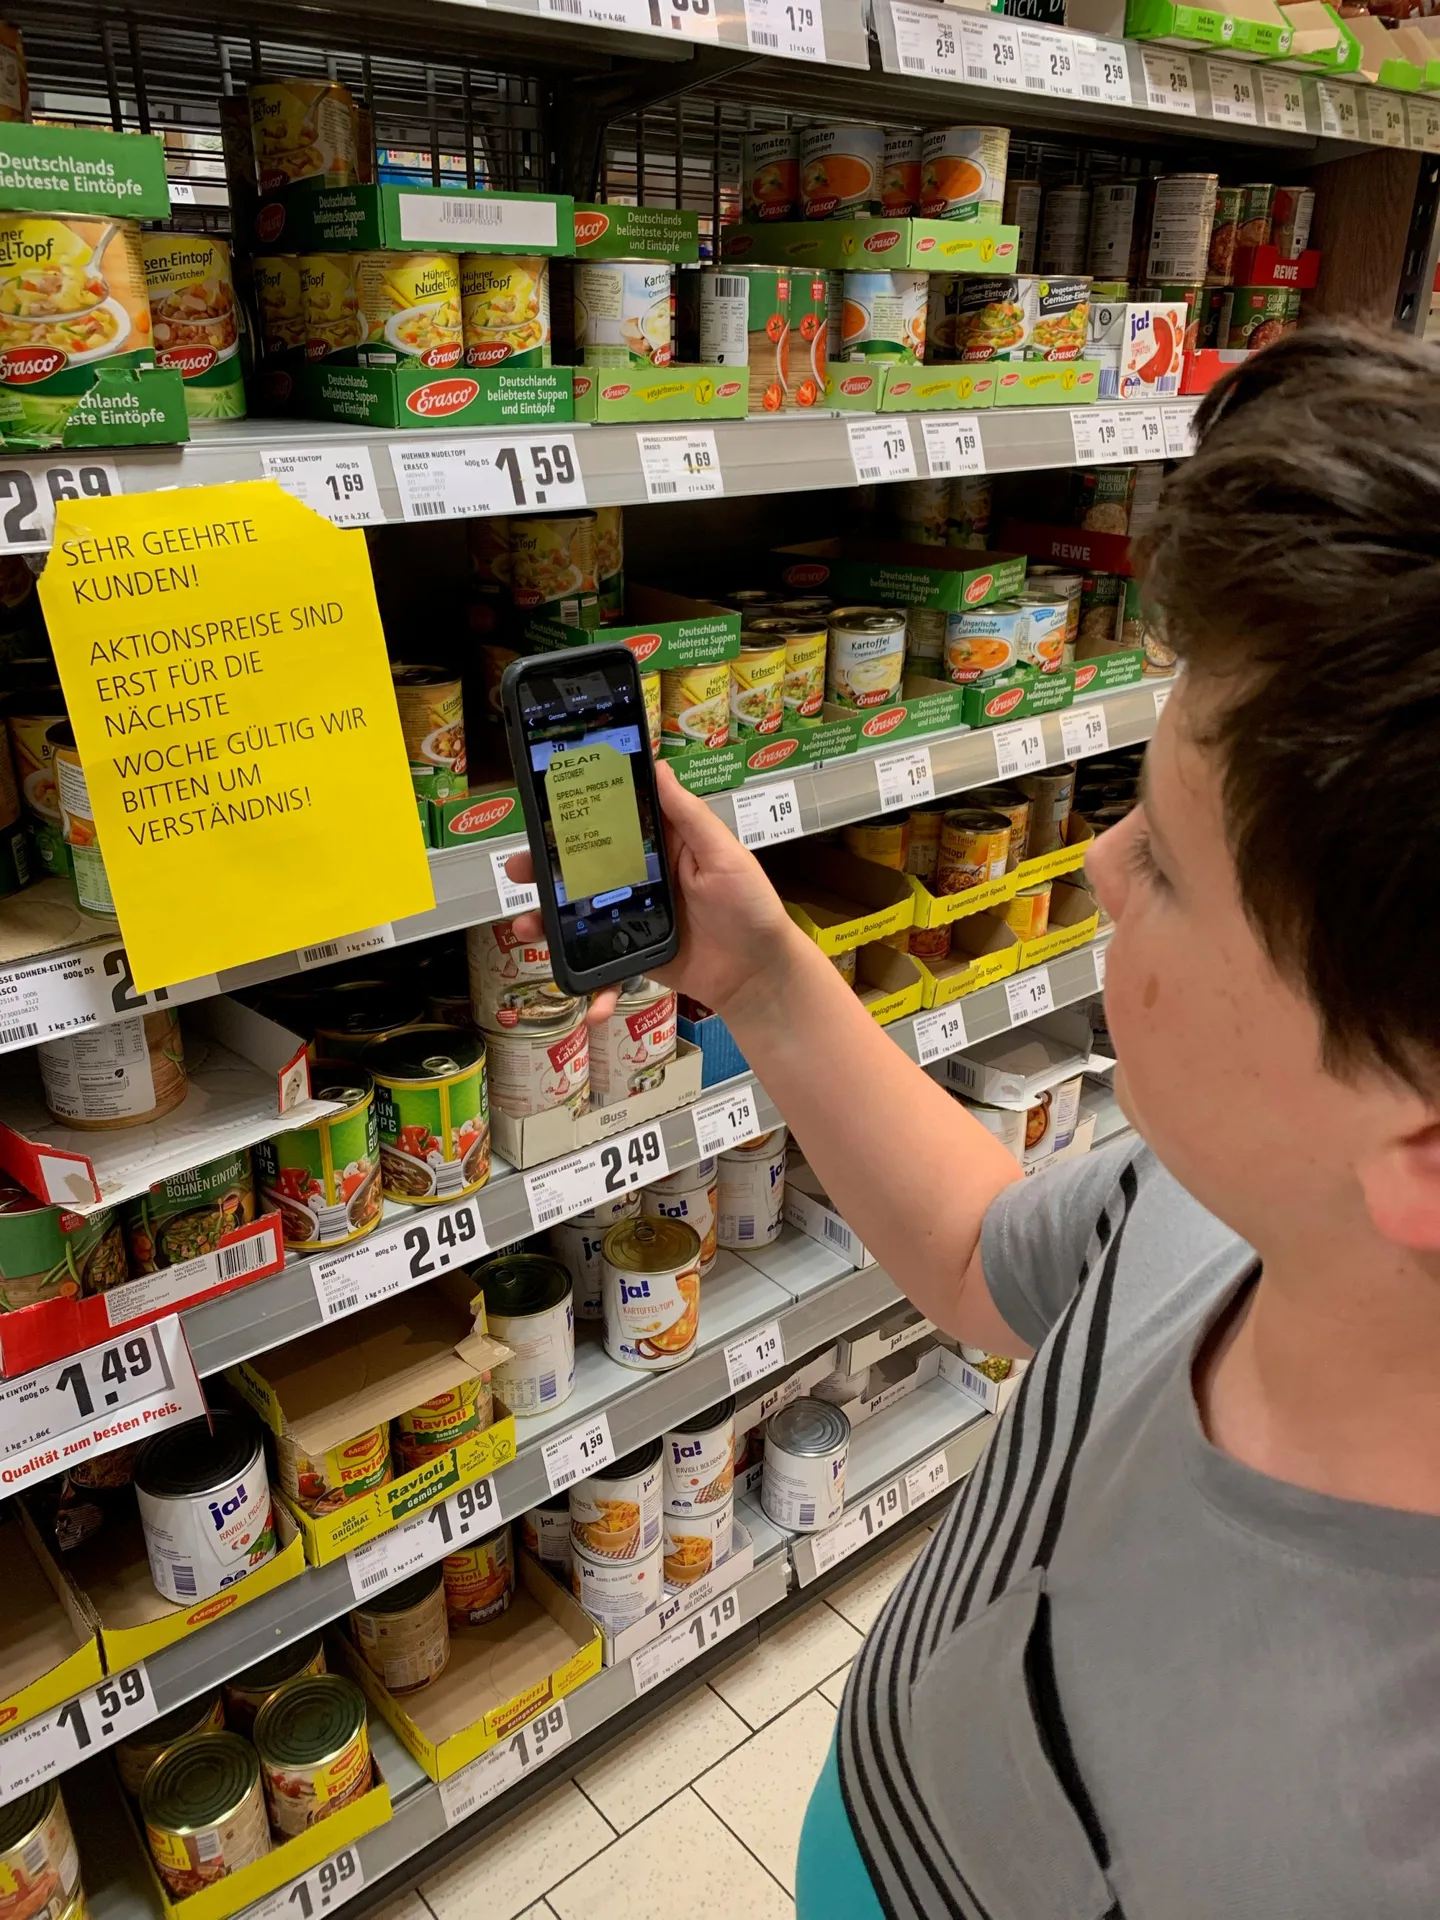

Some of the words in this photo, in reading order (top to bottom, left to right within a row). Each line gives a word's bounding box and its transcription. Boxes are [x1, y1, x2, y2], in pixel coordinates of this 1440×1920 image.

[786, 6, 814, 34] 1.79
[936, 38, 955, 58] 2.59
[993, 42, 1014, 66] 2.59
[1050, 53, 1071, 77] 2.59
[752, 136, 791, 153] Tomaten
[74, 179, 142, 198] Eintöpfe
[628, 212, 682, 226] Deutschlands
[616, 226, 660, 238] beliebteste
[662, 229, 692, 241] Suppen
[867, 231, 899, 251] Erasco
[629, 240, 647, 250] und
[649, 239, 680, 252] Eintöpfe
[161, 268, 205, 284] Würstchen
[422, 269, 450, 282] Hühner
[1273, 264, 1298, 280] REWE
[1130, 310, 1150, 341] ja!
[466, 344, 508, 364] Erasco
[328, 375, 368, 388] Deutschlands
[499, 376, 557, 388] Deutschlands
[417, 381, 472, 413] Erasco
[488, 389, 535, 402] beliebteste
[538, 389, 568, 402] Suppen
[101, 409, 165, 426] Eintöpfe
[502, 404, 519, 414] und
[521, 402, 555, 417] Eintöpfe
[1098, 426, 1116, 444] 1.99
[1142, 423, 1158, 441] 1.99
[401, 451, 429, 461] HUEHNER
[431, 449, 466, 459] NUDELTOPF
[883, 438, 906, 460] 1.79
[956, 435, 976, 455] 1.69
[403, 462, 429, 471] ERASCO
[683, 451, 711, 475] 1.69
[495, 444, 575, 506] 1.59
[326, 473, 364, 500] 1.69
[61, 534, 134, 568] SEHR
[144, 519, 259, 556] GEEHRTE
[1051, 542, 1091, 561] REWE
[72, 564, 200, 605] KUNDEN!
[879, 570, 931, 584] Deutschlands
[89, 610, 283, 666] AKTIONSPREISE
[289, 601, 345, 630] SIND
[678, 623, 728, 638] Deutschlands
[962, 619, 998, 630] Ungarische
[668, 637, 709, 649] beliebteste
[711, 633, 737, 646] Suppen
[851, 636, 891, 651] Kartoffel
[679, 649, 695, 659] und
[697, 646, 725, 659] Eintöpfe
[96, 669, 157, 702] ERST
[167, 659, 217, 690] FÜR
[226, 650, 264, 679] DIE
[1033, 678, 1067, 694] Deutschlands
[857, 691, 889, 705] Erasco
[918, 694, 954, 711] Deutschlands
[1026, 688, 1054, 701] beliebteste
[1056, 685, 1073, 697] Suppen
[548, 712, 567, 720] German
[596, 702, 612, 710] English
[910, 704, 940, 721] beliebteste
[941, 701, 959, 713] Suppen
[986, 692, 1024, 716] Erasco
[104, 693, 230, 738] NÄCHSTE
[863, 709, 906, 734] Erasco
[812, 726, 852, 742] Deutschlands
[1085, 721, 1102, 739] 1.69
[112, 738, 219, 779] WOCHE
[226, 717, 314, 756] GÜLTIG
[319, 706, 367, 734] WIR
[801, 736, 835, 752] beliebteste
[836, 732, 857, 745] Suppen
[1021, 736, 1039, 756] 1.79
[549, 753, 600, 771] DEAR
[689, 752, 734, 769] Deutschlands
[749, 741, 796, 768] Erasco
[552, 768, 585, 784] CUSTOMER!
[679, 764, 718, 779] beliebteste
[720, 761, 742, 773] Suppen
[907, 766, 927, 786] 1.69
[121, 775, 209, 813] BITTEN
[219, 763, 262, 792] UM
[556, 787, 584, 800] SPECIAL
[586, 780, 610, 794] PRICES
[611, 776, 624, 788] ARE
[690, 778, 703, 788] und
[706, 773, 732, 788] Eintöpfe
[558, 800, 575, 810] FIRST
[576, 798, 589, 806] FOR
[590, 794, 602, 804] THE
[769, 801, 792, 822] 1.69
[127, 786, 313, 846] VERSTÄNDNIS!
[560, 806, 590, 822] NEXT
[565, 834, 581, 844] ASK
[584, 829, 600, 838] FOR
[565, 836, 612, 856] UNDERSTANDING!
[947, 895, 978, 912] Linsentopf
[979, 890, 989, 900] mit
[991, 884, 1007, 897] Speck
[835, 929, 860, 943] Ravioli
[15, 958, 82, 980] BOHNEN-EINTOPF
[63, 970, 83, 980] 800g
[1029, 984, 1046, 1003] 1.39
[55, 1022, 65, 1030] kg
[73, 1013, 96, 1025] 3.36€
[940, 1019, 959, 1039] 1.39
[728, 1105, 750, 1128] 1.79
[530, 1165, 556, 1183] HANSEATEN
[558, 1159, 582, 1173] LABSKAUS
[600, 1130, 660, 1193] 2.49
[167, 1177, 211, 1197] BOHNEN
[212, 1160, 244, 1185] EINTOPF
[532, 1182, 545, 1191] BUSS
[403, 1208, 476, 1279] 2.49
[318, 1252, 356, 1272] BIHUNSUPPE
[356, 1246, 370, 1256] ASIA
[374, 1247, 389, 1258] 800g
[390, 1243, 398, 1251] DS
[321, 1269, 337, 1280] BUSS
[619, 1279, 650, 1302] ja!
[755, 1338, 777, 1361] 1.19
[55, 1337, 153, 1418] 1.49
[6, 1380, 37, 1398] EINTOPF
[19, 1390, 38, 1403] 800g
[39, 1385, 50, 1394] DS
[412, 1408, 467, 1431] Ravioli
[1, 1449, 60, 1484] Qualität
[63, 1438, 92, 1458] zum
[94, 1417, 140, 1442] besten
[142, 1403, 182, 1422] Preis.
[579, 1433, 603, 1458] 1.59
[672, 1440, 703, 1464] ja!
[387, 1461, 445, 1503] Ravioli
[407, 1482, 443, 1509] Gemüse
[208, 1484, 248, 1531] ja!
[428, 1479, 492, 1544] 1.99
[858, 1488, 897, 1535] 1.19
[219, 1518, 248, 1541] RAVIOLI
[332, 1515, 369, 1541] ORIGINAL
[342, 1516, 356, 1527] DAS
[404, 1522, 417, 1533] 800g
[658, 1600, 680, 1630] ja!
[688, 1596, 735, 1648] 1.19
[56, 1668, 146, 1750] 1.59
[489, 1684, 546, 1729] Spaghetti
[509, 1706, 564, 1767] 1.99
[288, 1850, 356, 1919] 1.99
